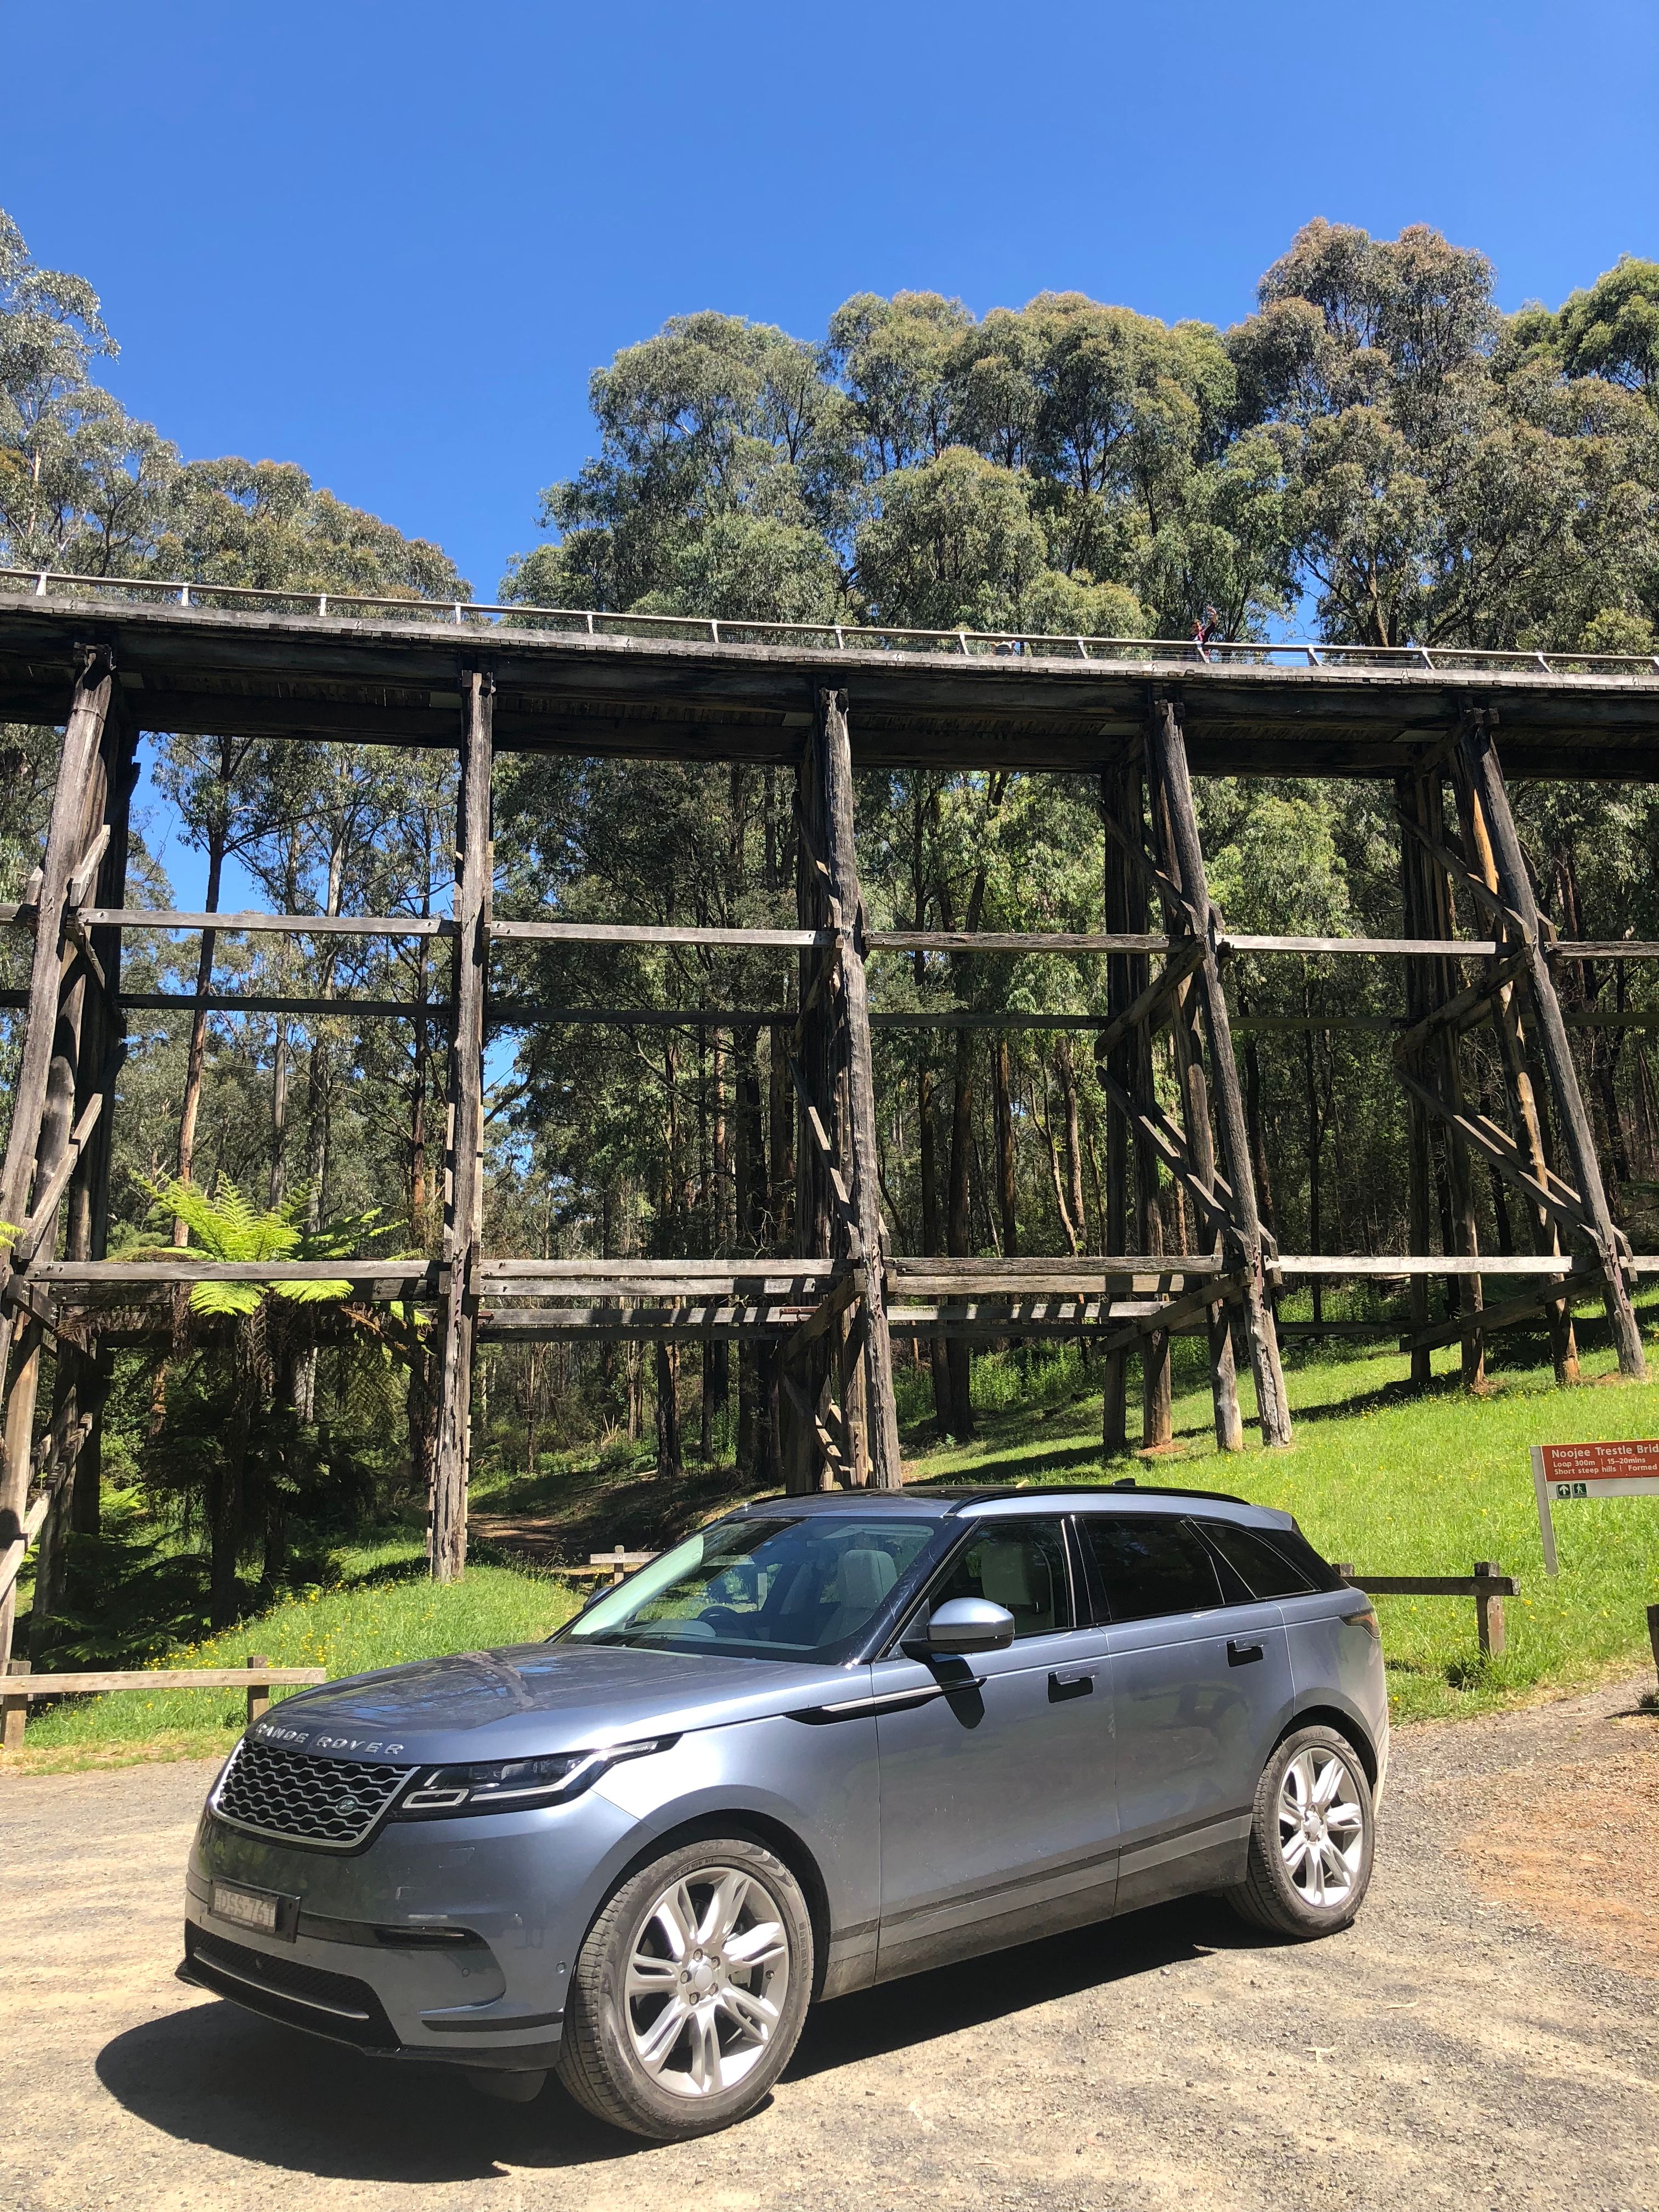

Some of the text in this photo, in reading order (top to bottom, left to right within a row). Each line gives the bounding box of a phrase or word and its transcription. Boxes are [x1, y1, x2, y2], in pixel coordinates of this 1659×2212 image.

[1551, 1448, 1590, 1459] Noojee
[1595, 1445, 1633, 1455] Trestle
[1628, 1463, 1657, 1471] Formed
[255, 1722, 404, 1755] RANGE ROVER
